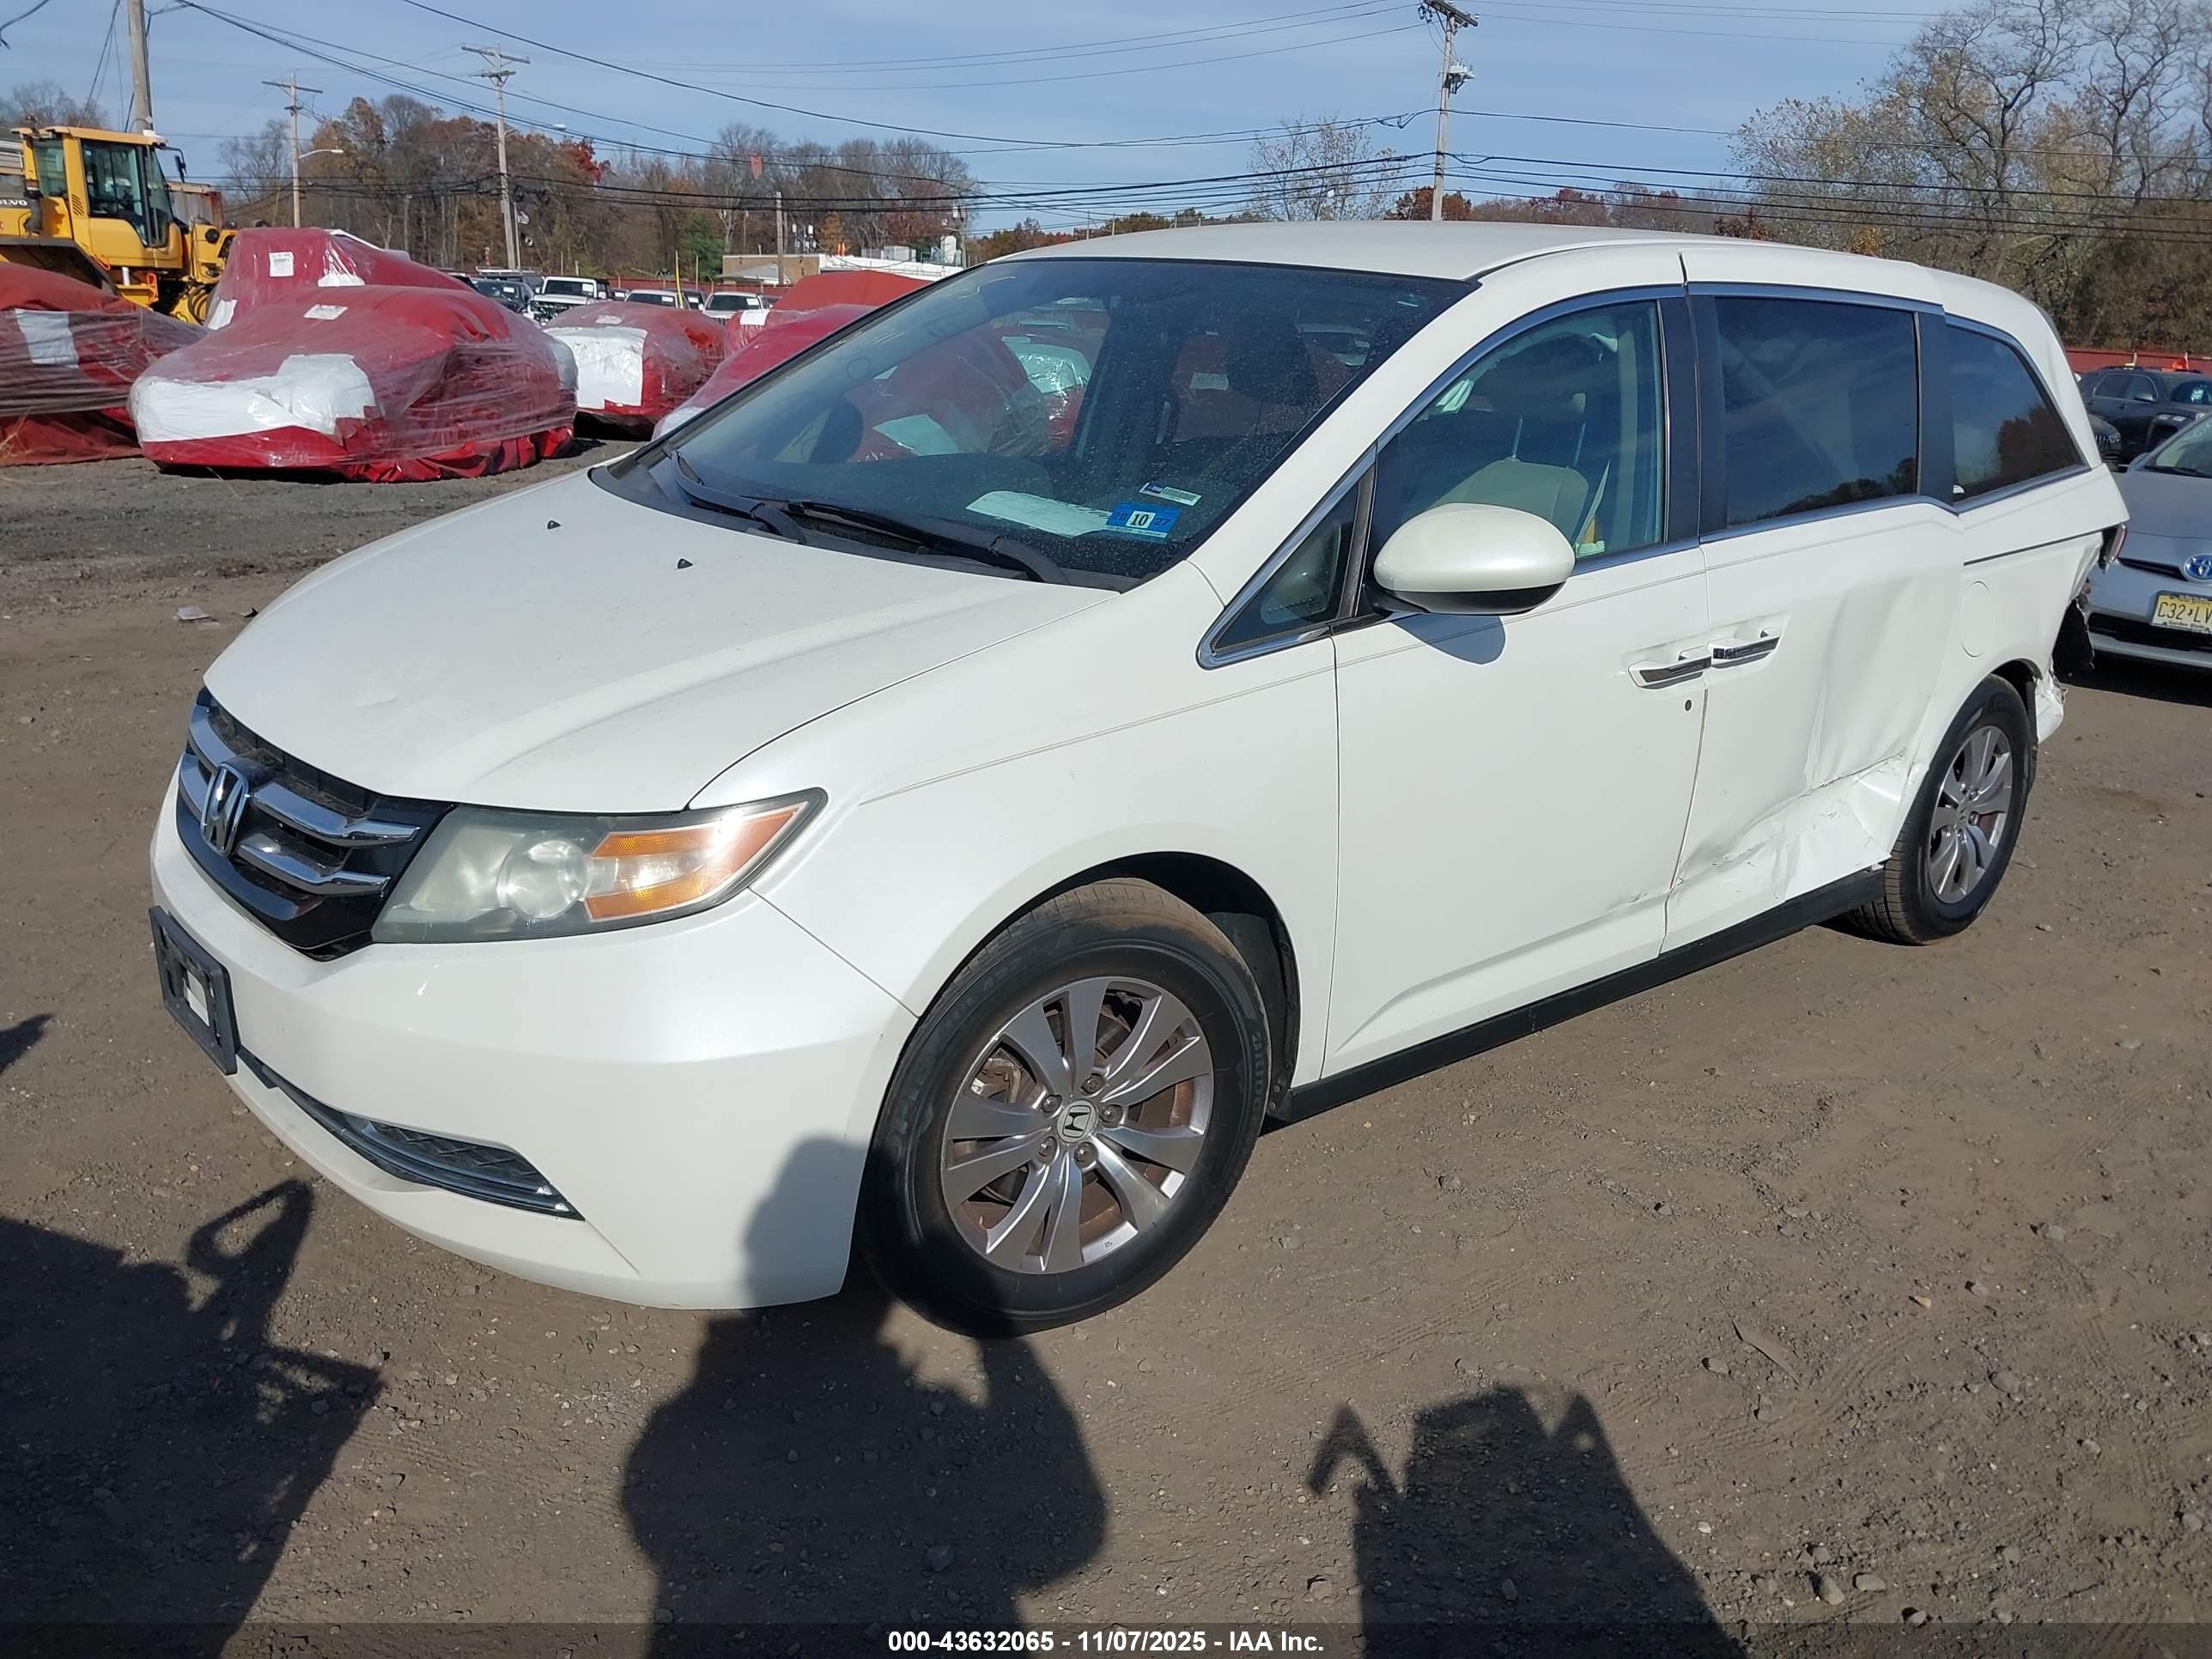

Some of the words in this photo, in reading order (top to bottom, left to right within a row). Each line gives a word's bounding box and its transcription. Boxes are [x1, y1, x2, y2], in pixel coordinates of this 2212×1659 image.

[1114, 513, 1127, 521] 20
[1130, 514, 1149, 526] 10
[1153, 517, 1170, 526] 27
